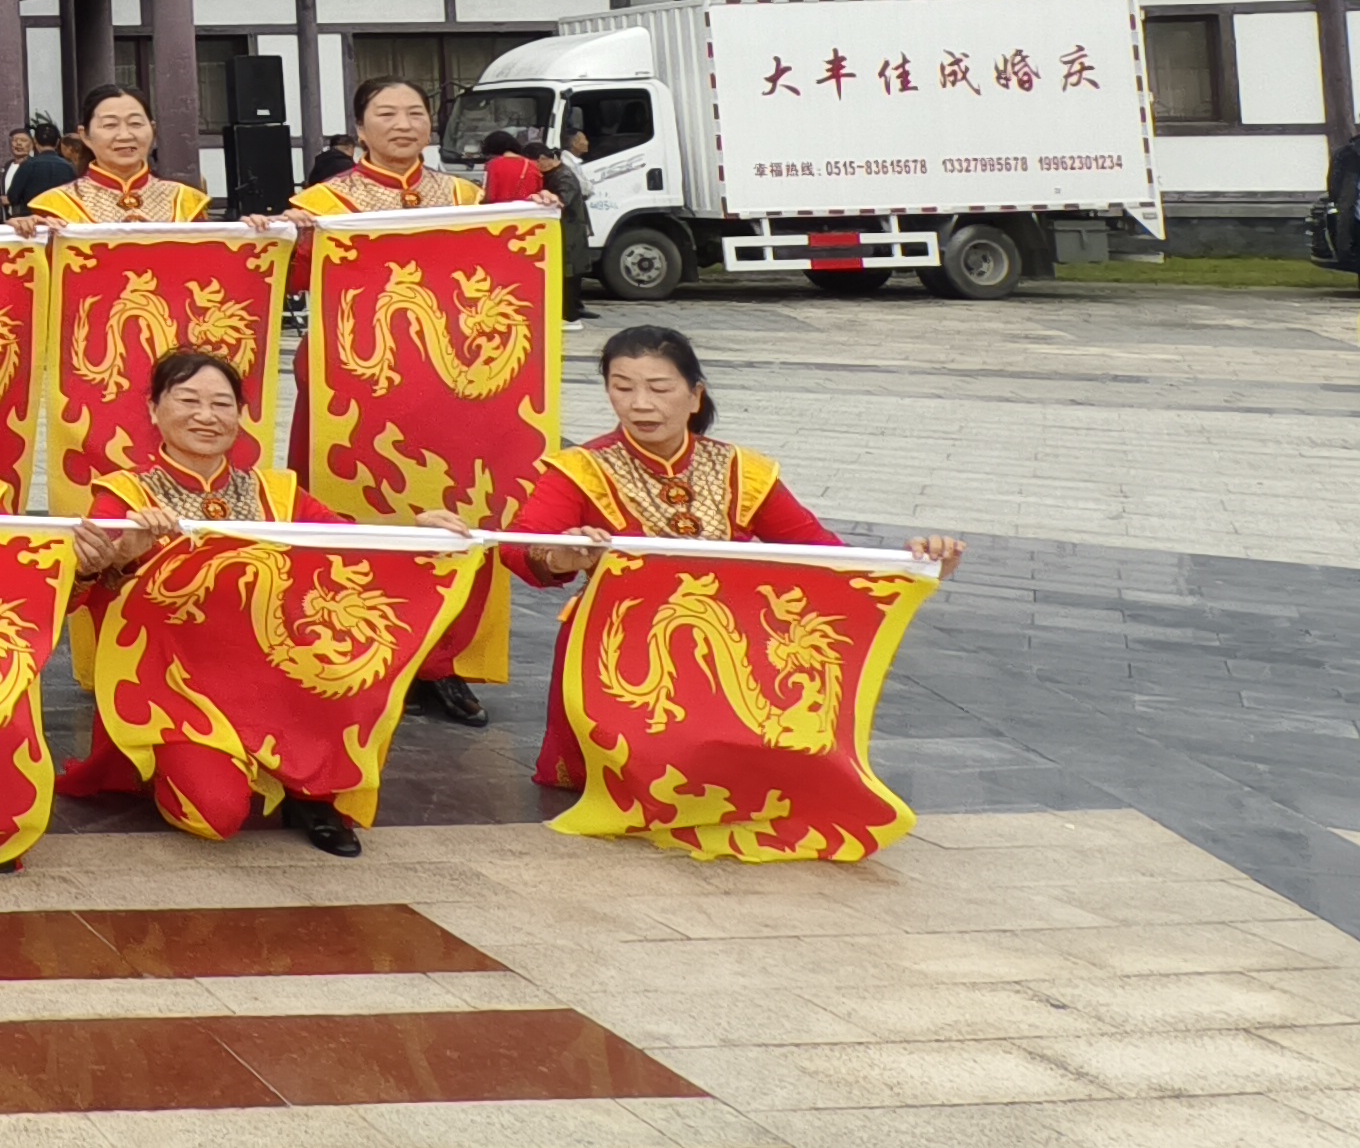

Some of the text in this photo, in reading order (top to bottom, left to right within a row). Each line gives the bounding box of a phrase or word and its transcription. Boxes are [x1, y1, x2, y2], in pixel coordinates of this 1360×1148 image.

[762, 45, 1100, 100] 大丰佳成婚庆
